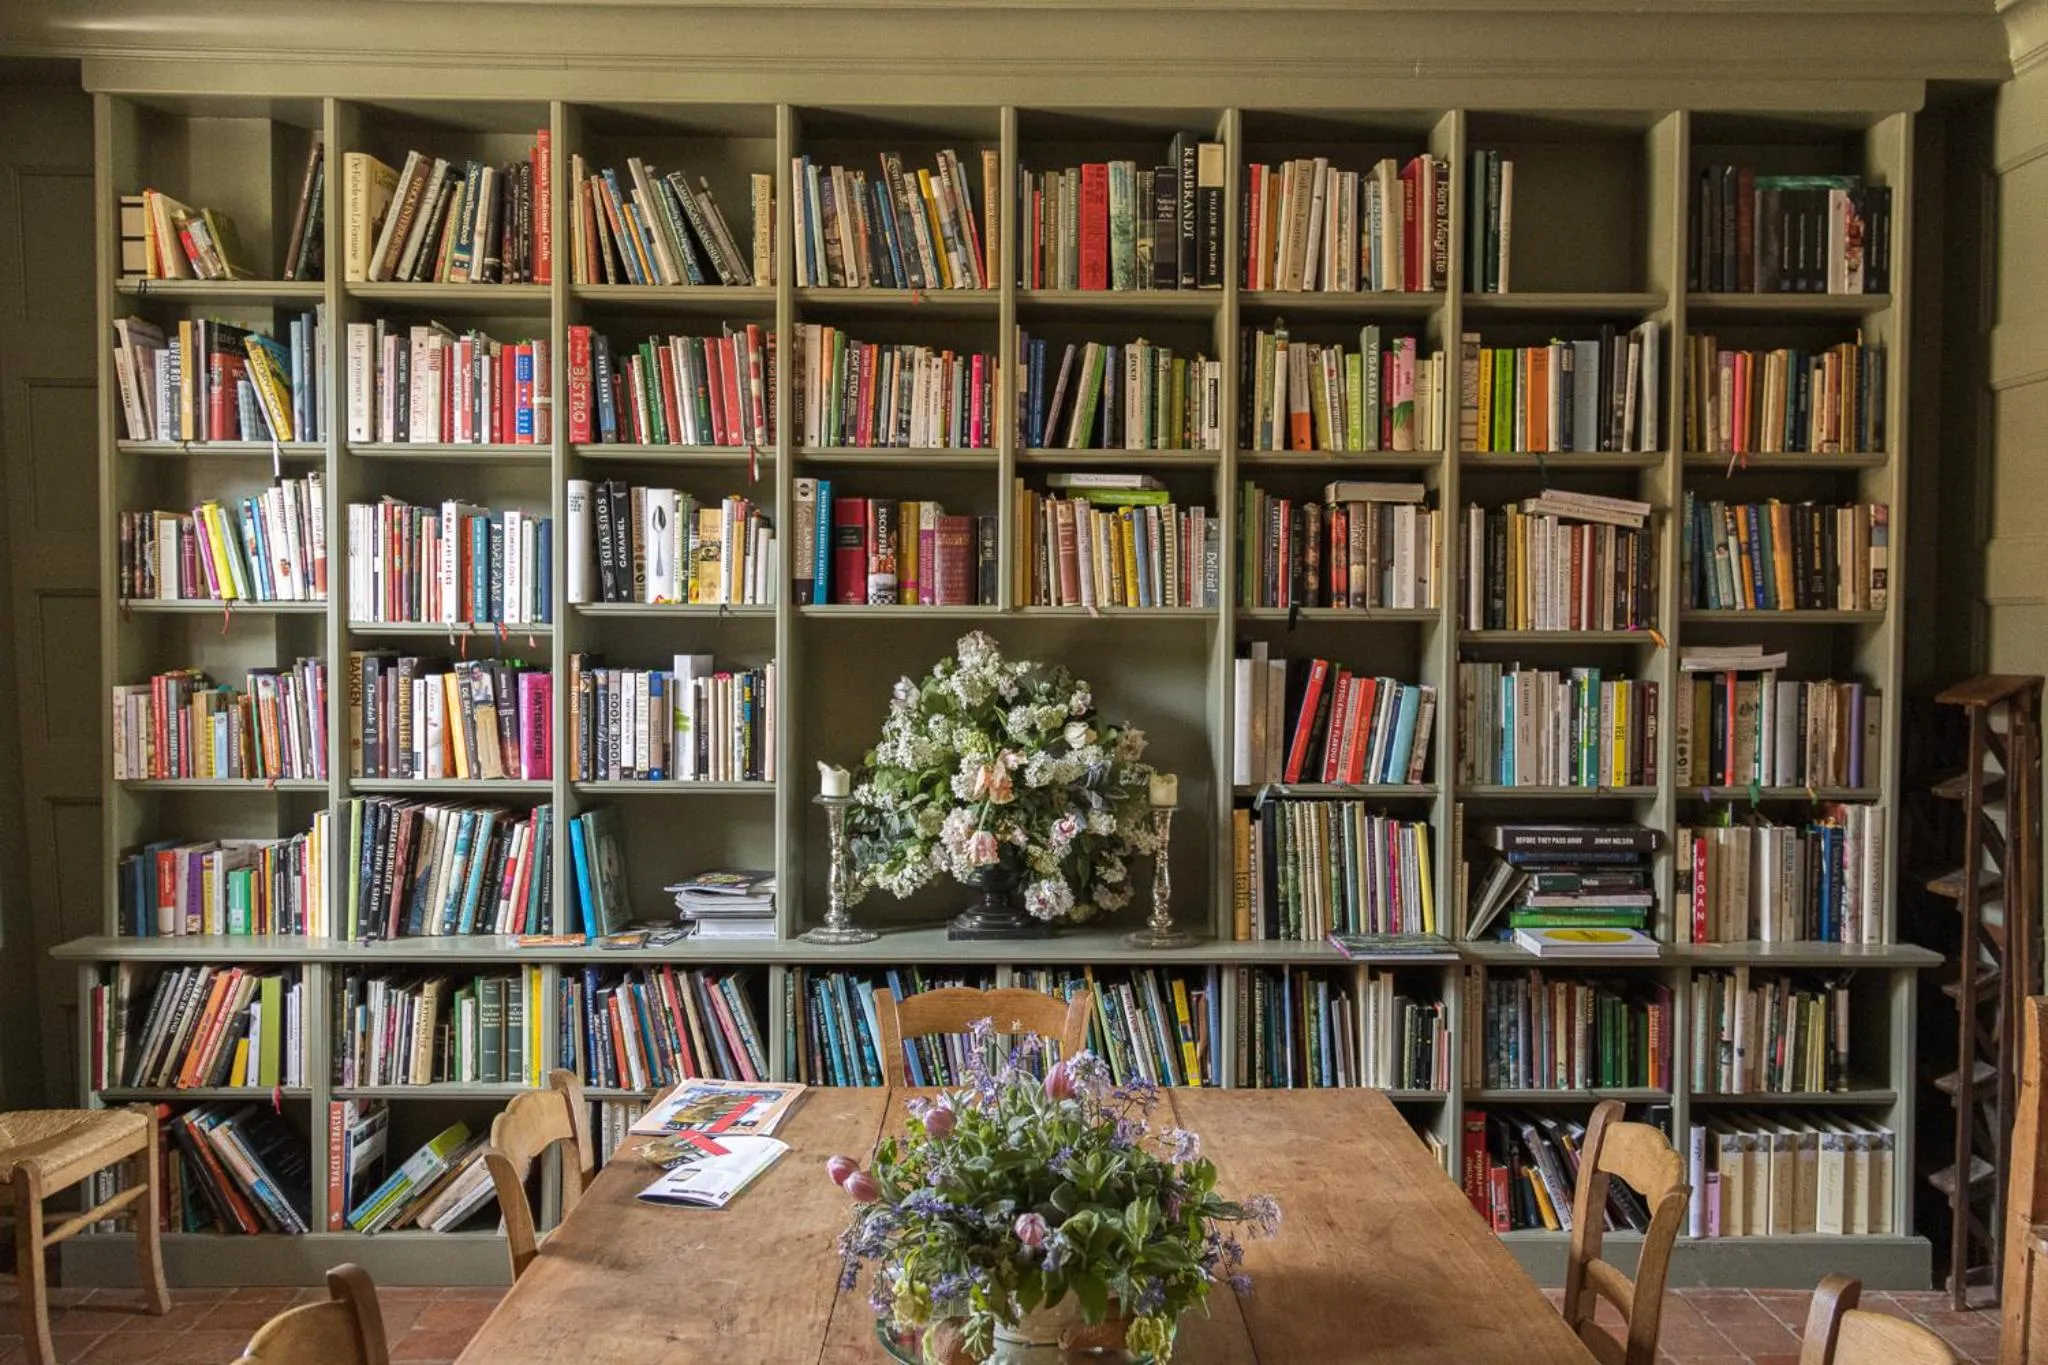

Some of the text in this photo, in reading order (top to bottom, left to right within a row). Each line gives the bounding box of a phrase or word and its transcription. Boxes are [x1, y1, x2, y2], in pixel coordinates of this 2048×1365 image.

[1183, 147, 1194, 240] REMBRANDT
[1434, 219, 1449, 272] Magritte
[571, 367, 587, 423] BISTRO
[596, 497, 613, 566] SOUS-VIDE
[618, 517, 627, 568] CARAMEL
[878, 508, 887, 560] ESCOFFIER
[1204, 551, 1218, 592] Delizia!
[349, 656, 361, 707] BAKKEN
[637, 674, 647, 726] TARTINE
[1333, 678, 1347, 728] OTTOLENGHI
[399, 676, 409, 749] CHOCOLATIER
[609, 692, 620, 767] cook book
[1236, 871, 1250, 909] Italia
